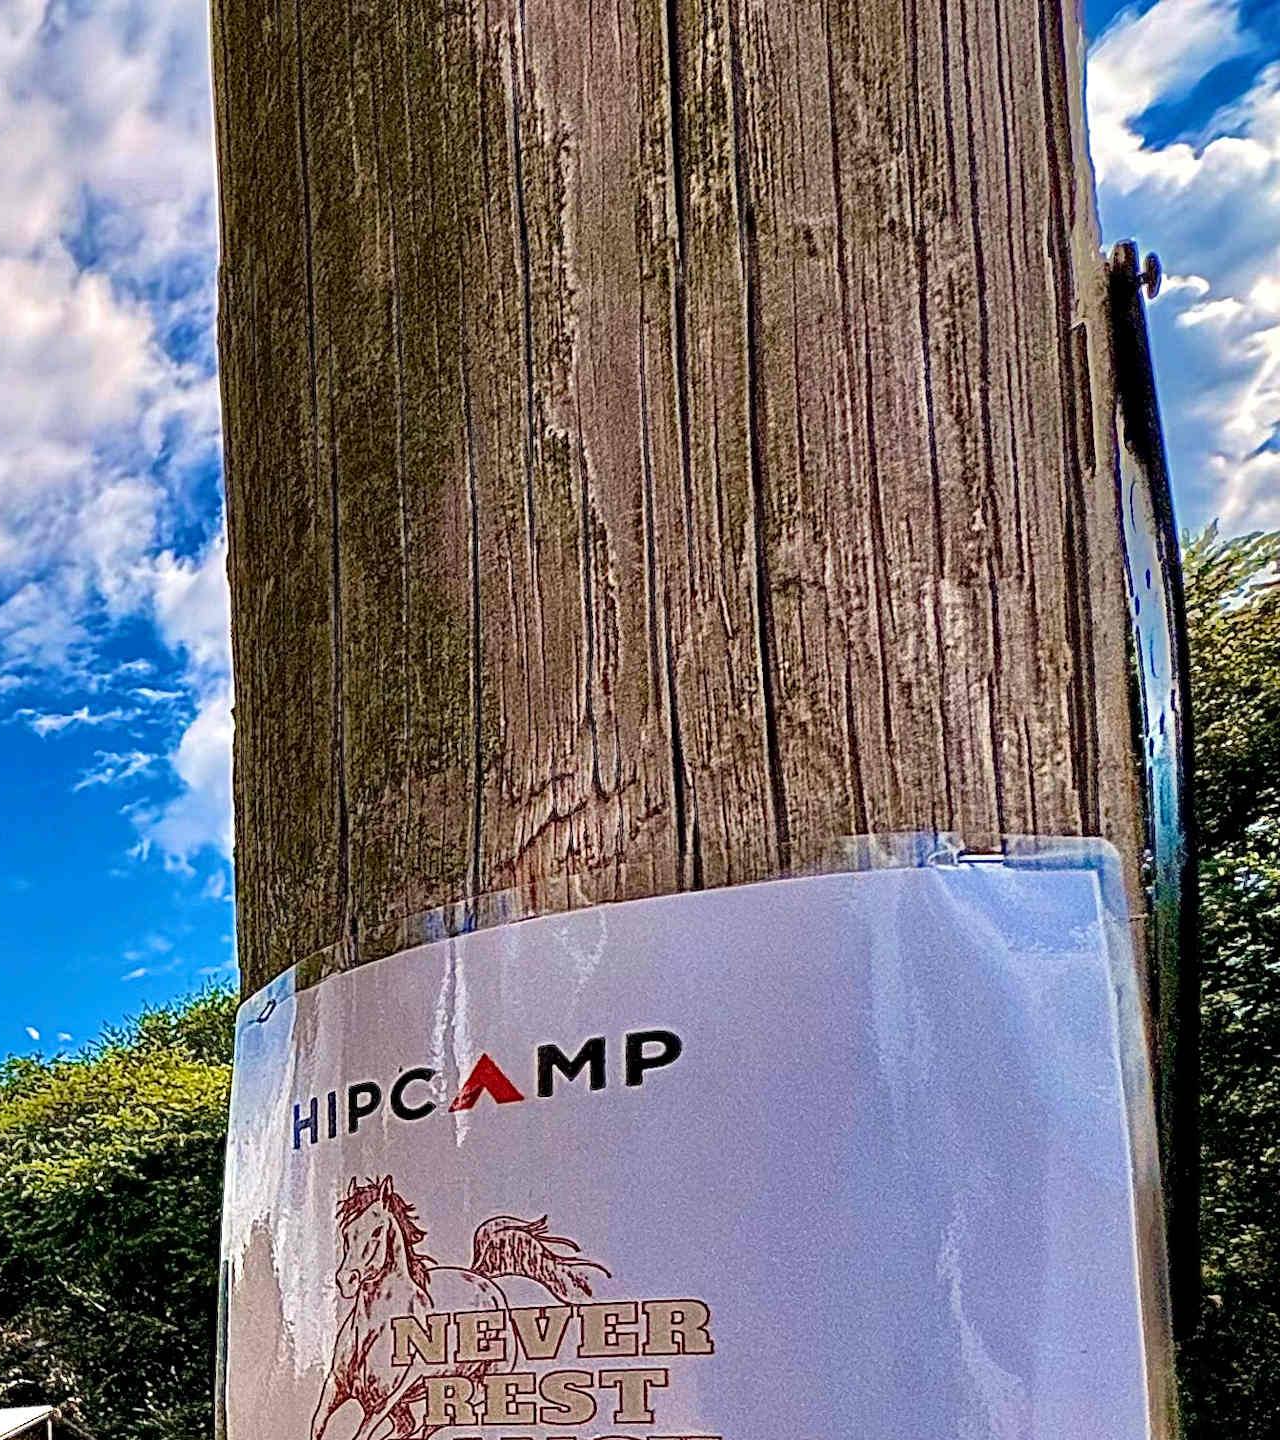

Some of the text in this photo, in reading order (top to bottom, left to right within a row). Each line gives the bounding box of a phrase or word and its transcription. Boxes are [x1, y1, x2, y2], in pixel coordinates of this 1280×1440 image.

[293, 1030, 683, 1149] HIPCAMP
[391, 1299, 715, 1366] NEVER
[423, 1368, 669, 1426] REST
